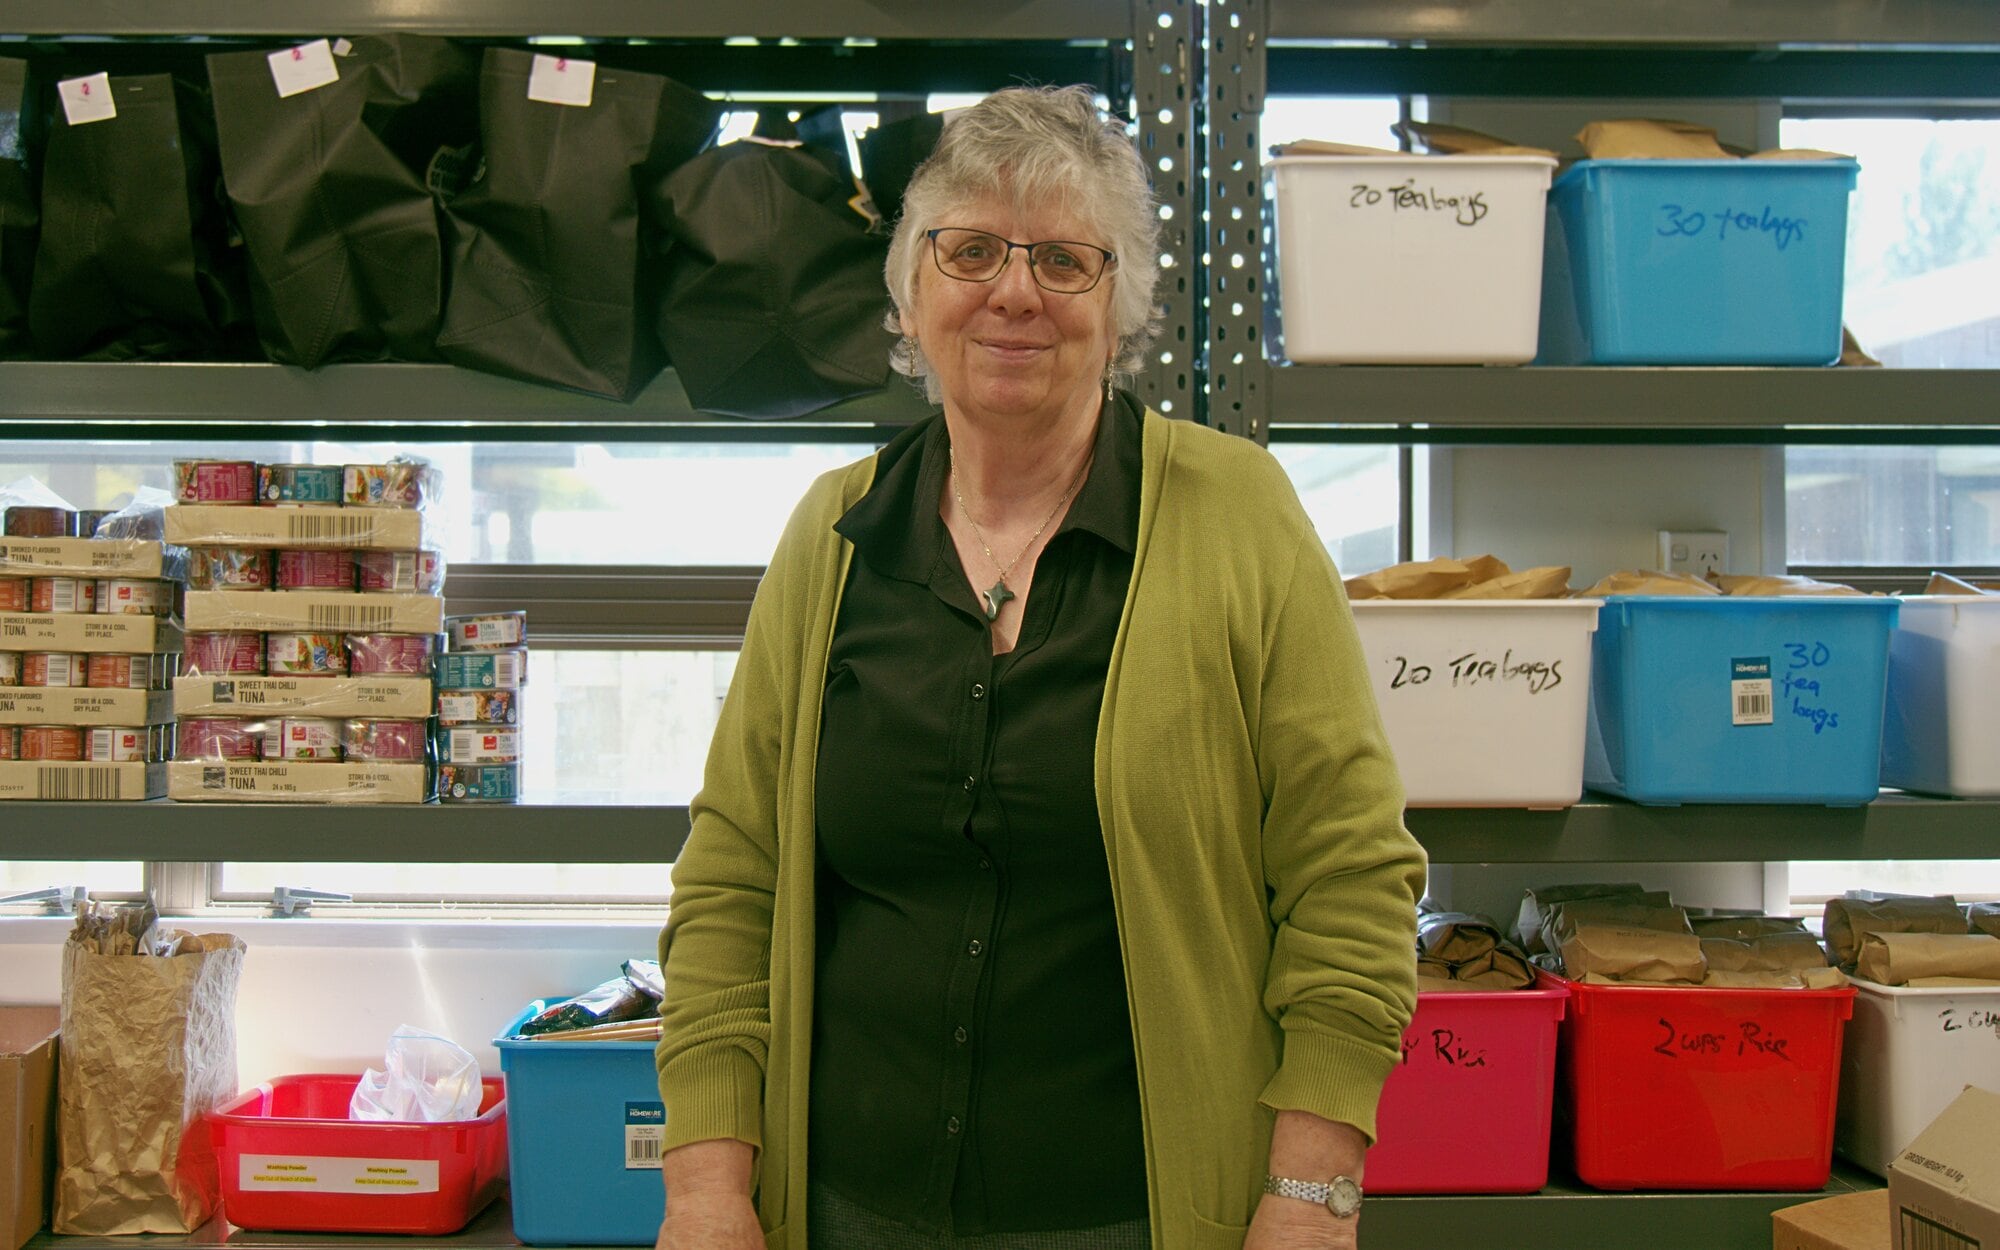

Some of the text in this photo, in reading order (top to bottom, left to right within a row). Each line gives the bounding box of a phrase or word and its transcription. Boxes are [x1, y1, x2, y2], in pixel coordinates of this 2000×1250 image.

[1350, 185, 1382, 208] 20
[1657, 204, 1706, 237] 30
[11, 546, 33, 554] SMOKED
[4, 617, 54, 626] SMOKED FLAVOURED
[4, 625, 27, 636] TUNA
[1784, 641, 1830, 669] 30
[1391, 656, 1432, 689] 20
[239, 680, 297, 690] SWEET THAI CHILLI
[357, 687, 375, 695] STORE
[1780, 672, 1820, 698] tea
[239, 691, 266, 703] TUNA
[0, 701, 15, 711] UNA
[1792, 697, 1839, 735] bags
[229, 767, 287, 776] SWEET THAI CHILLI
[229, 777, 256, 790] TUNA
[1938, 1008, 1963, 1032] 2
[1654, 1018, 1678, 1058] 2
